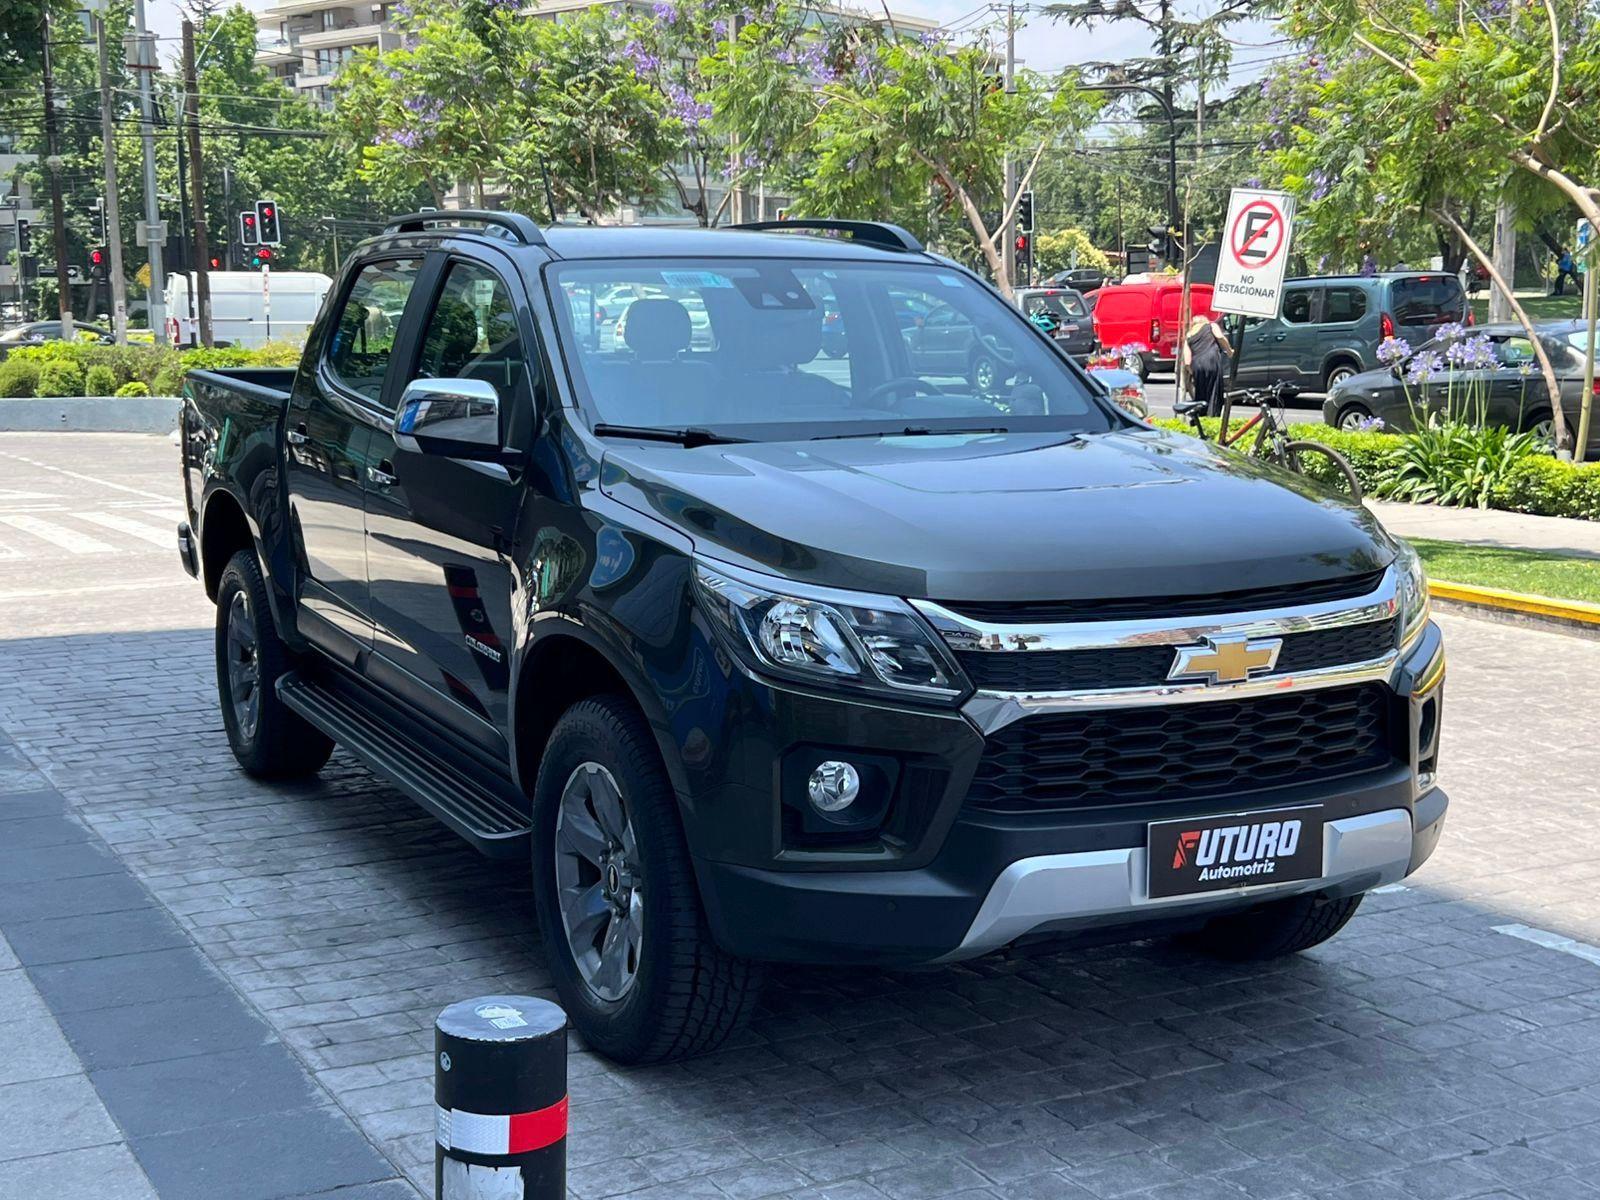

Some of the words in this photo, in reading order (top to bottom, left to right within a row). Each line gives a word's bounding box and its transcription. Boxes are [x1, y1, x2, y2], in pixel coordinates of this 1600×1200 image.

[1241, 211, 1273, 258] E
[1240, 274, 1254, 284] NO
[1218, 283, 1275, 298] ESTACIONAR
[1172, 820, 1302, 869] FUTURO
[1198, 859, 1276, 881] Automotriz
